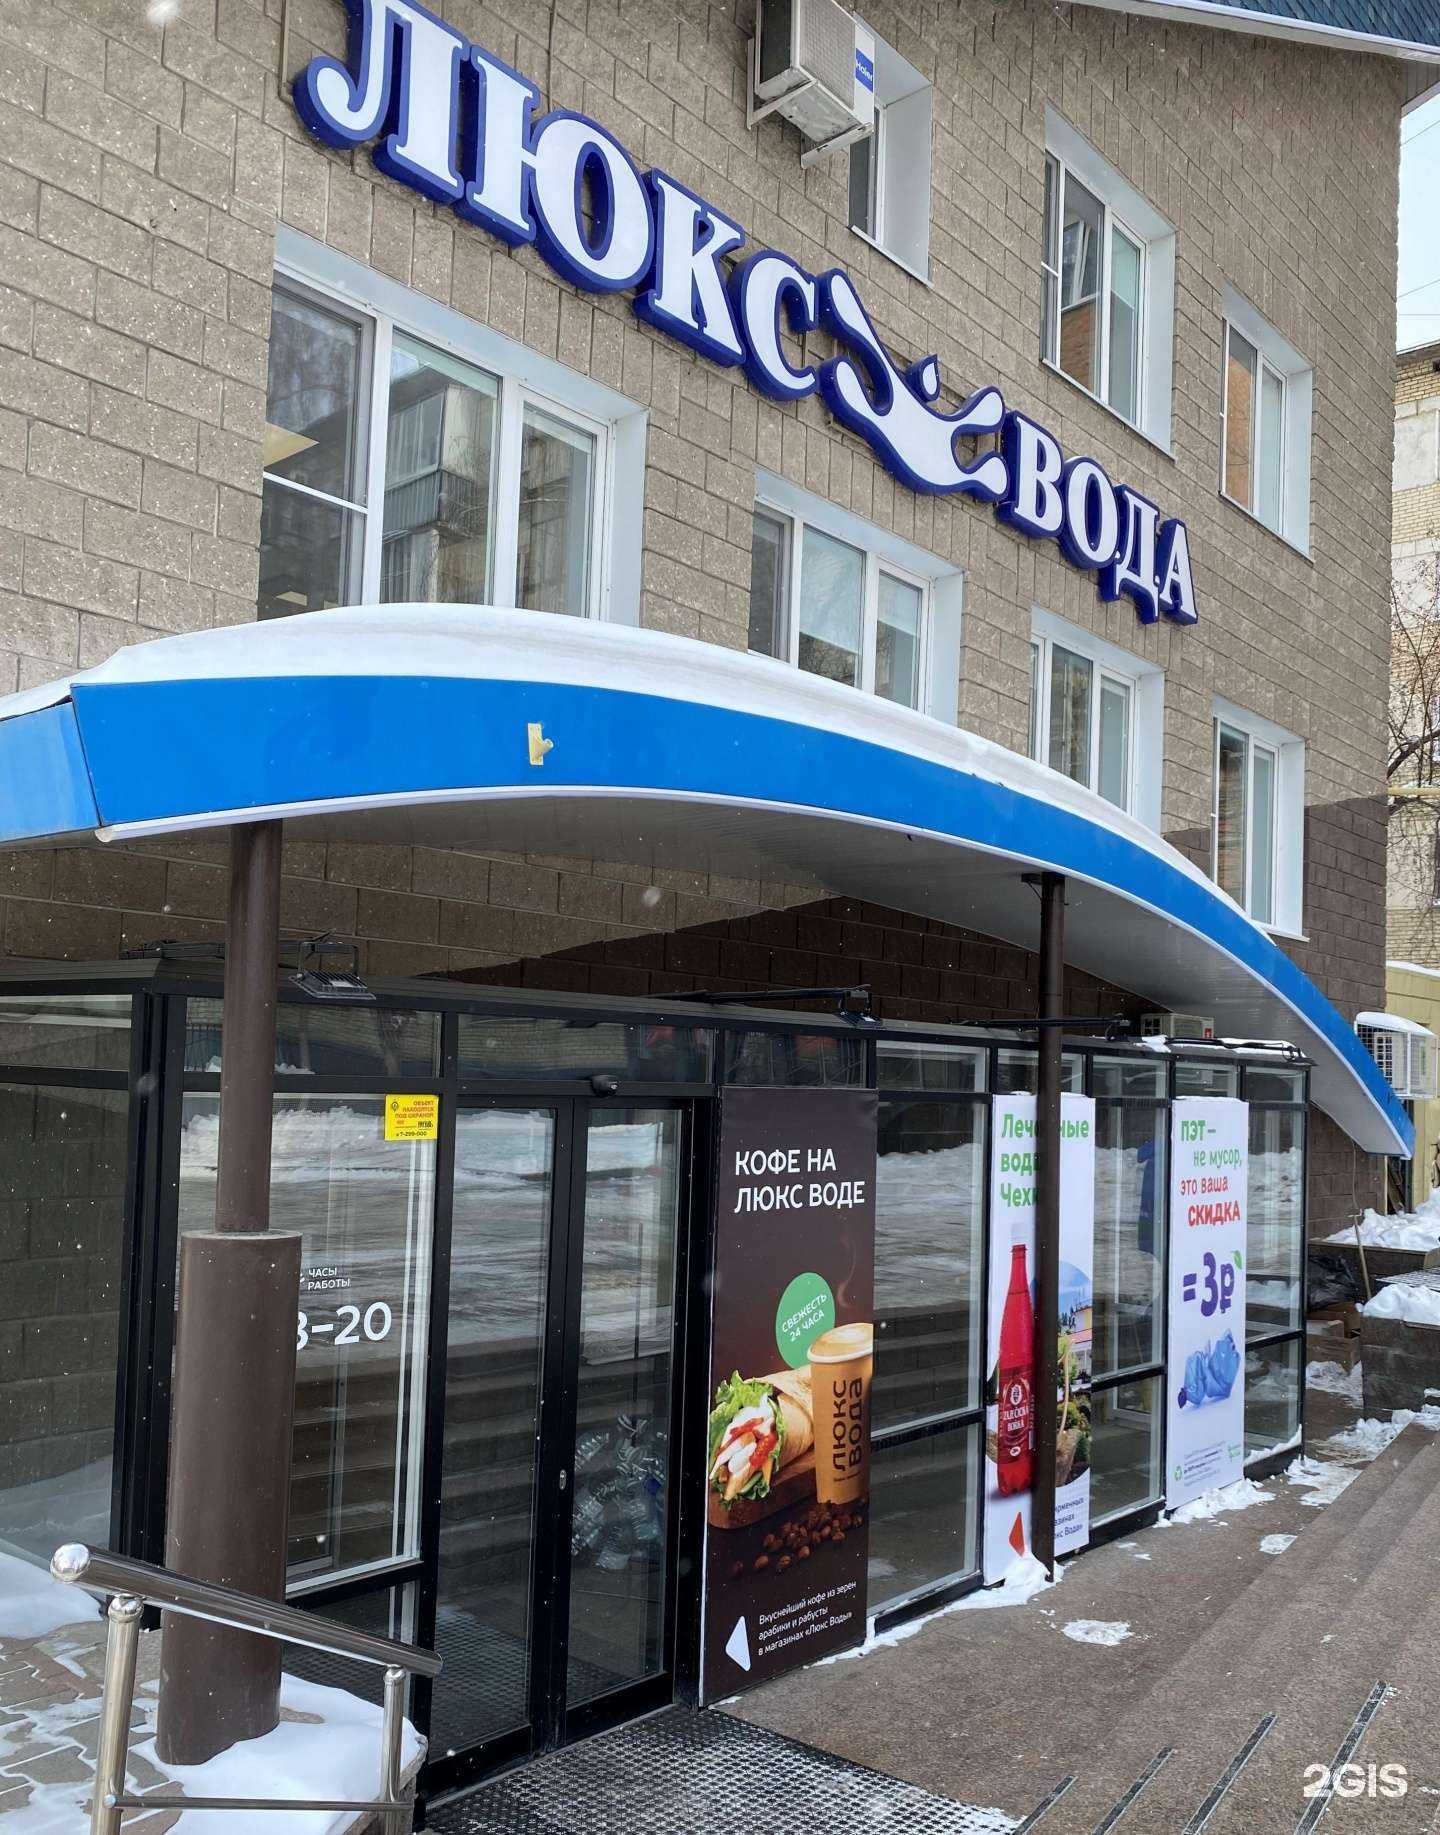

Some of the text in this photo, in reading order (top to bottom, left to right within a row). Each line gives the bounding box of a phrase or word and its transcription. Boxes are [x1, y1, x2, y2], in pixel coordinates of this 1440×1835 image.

[296, 0, 818, 400] ЛЮКС
[998, 411, 1198, 625] ВОДА
[1001, 1113, 1089, 1138] Лечные
[735, 1148, 837, 1176] КОФЕ НА
[1193, 1147, 1243, 1170] не мусор,
[734, 1180, 866, 1214] ЛЮКС ВОДЕ
[1180, 1175, 1229, 1196] это ваша
[1187, 1200, 1242, 1228] СКИДКА
[307, 1267, 338, 1278] ЧАСЫ
[307, 1278, 352, 1291] РАБОТЫ
[781, 1292, 828, 1333] СВЕЖЕСТЬ
[789, 1309, 825, 1342] 24 ЧАСА
[758, 1580, 857, 1626] Вкуснейший кофе из зерен
[758, 1622, 791, 1641] арабики
[764, 1631, 804, 1654] магазинах
